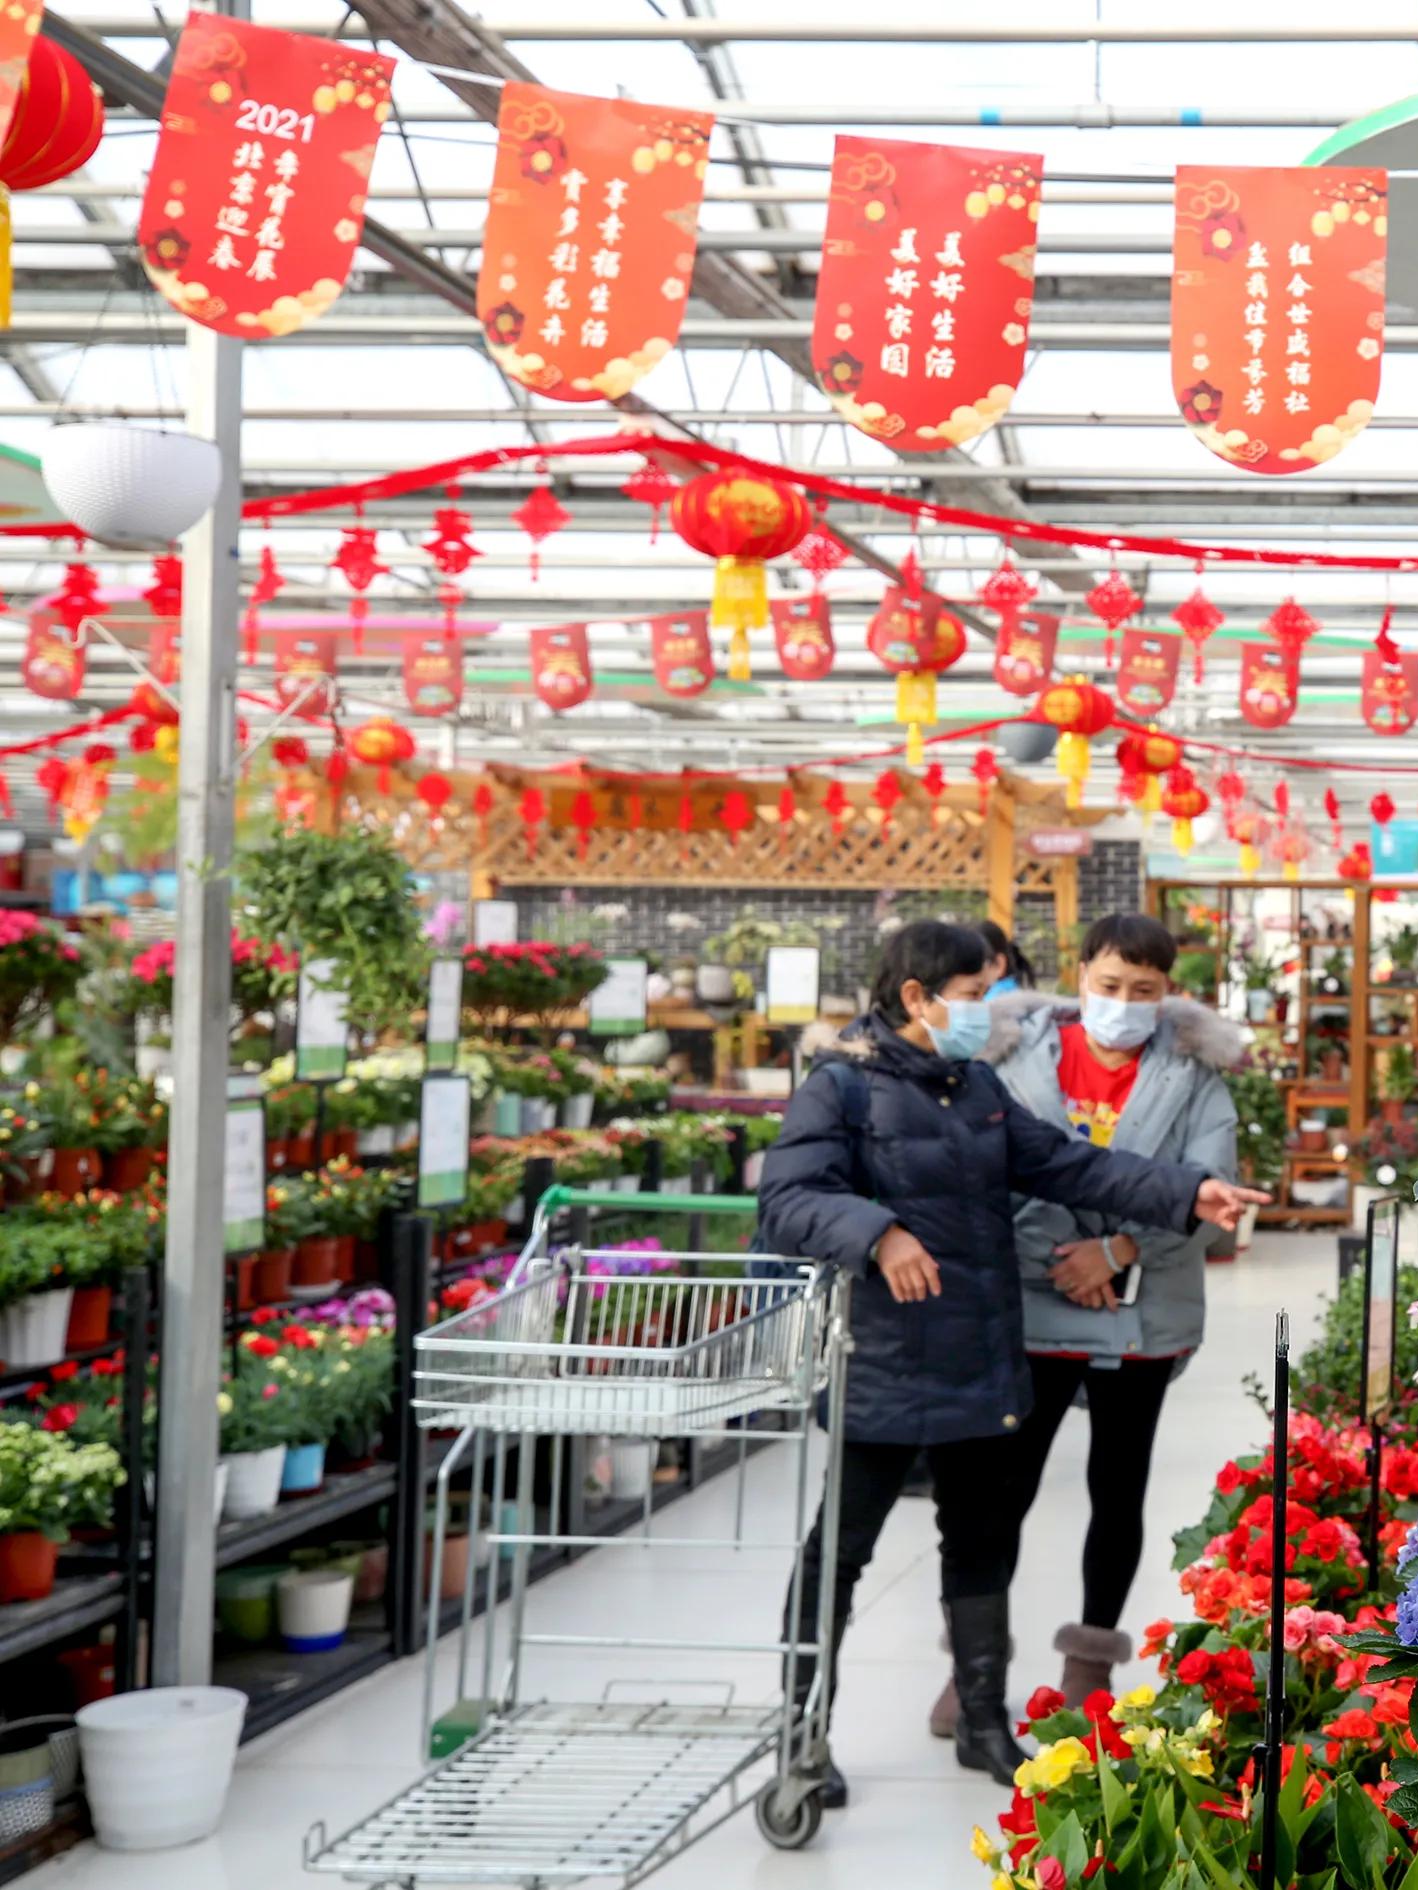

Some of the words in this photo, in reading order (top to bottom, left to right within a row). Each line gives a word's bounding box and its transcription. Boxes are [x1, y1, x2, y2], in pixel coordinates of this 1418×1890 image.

[235, 99, 315, 143] 2021
[208, 141, 265, 270] 北京迎春
[246, 149, 299, 282] 年宵花展
[539, 167, 588, 346] 赏多彩花卉
[580, 177, 629, 348] 享幸福生活
[880, 227, 921, 378] 美好家园
[925, 231, 965, 379] 美好生活
